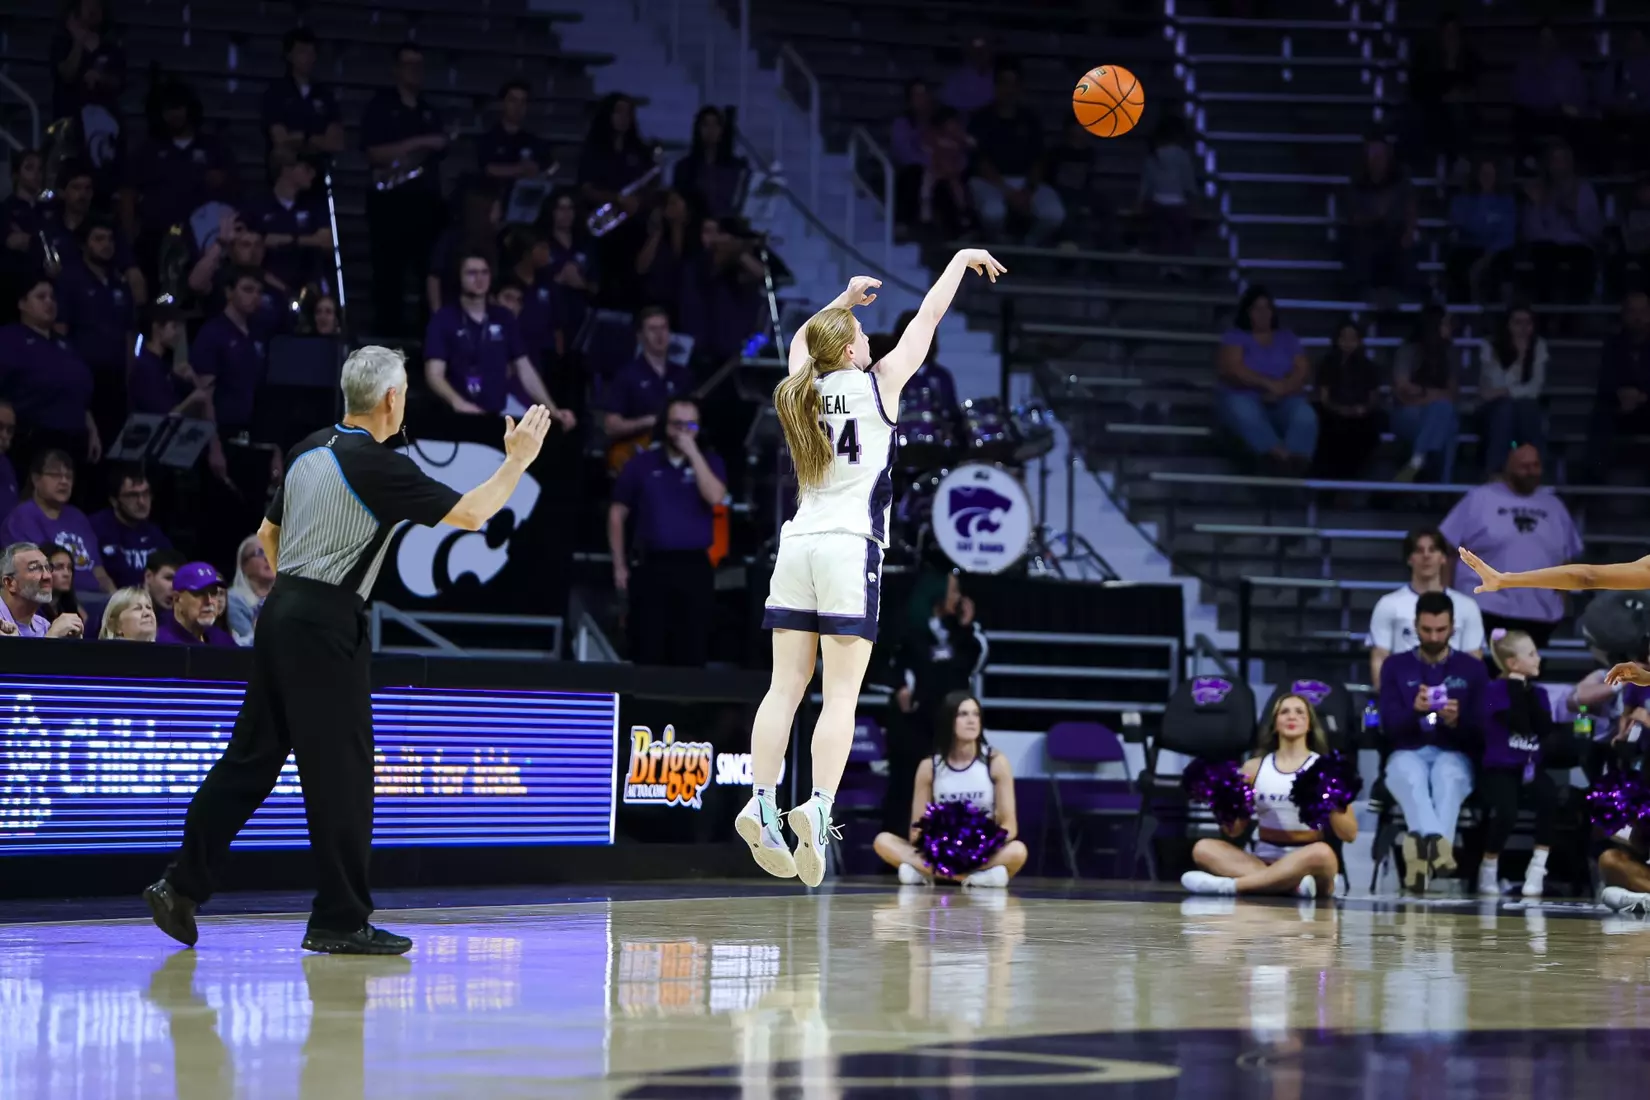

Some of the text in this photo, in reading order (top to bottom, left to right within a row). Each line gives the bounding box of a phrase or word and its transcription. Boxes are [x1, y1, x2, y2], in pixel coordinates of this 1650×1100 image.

[431, 747, 468, 794] for
[629, 724, 713, 801] Briggs
[715, 752, 754, 786] SINC
